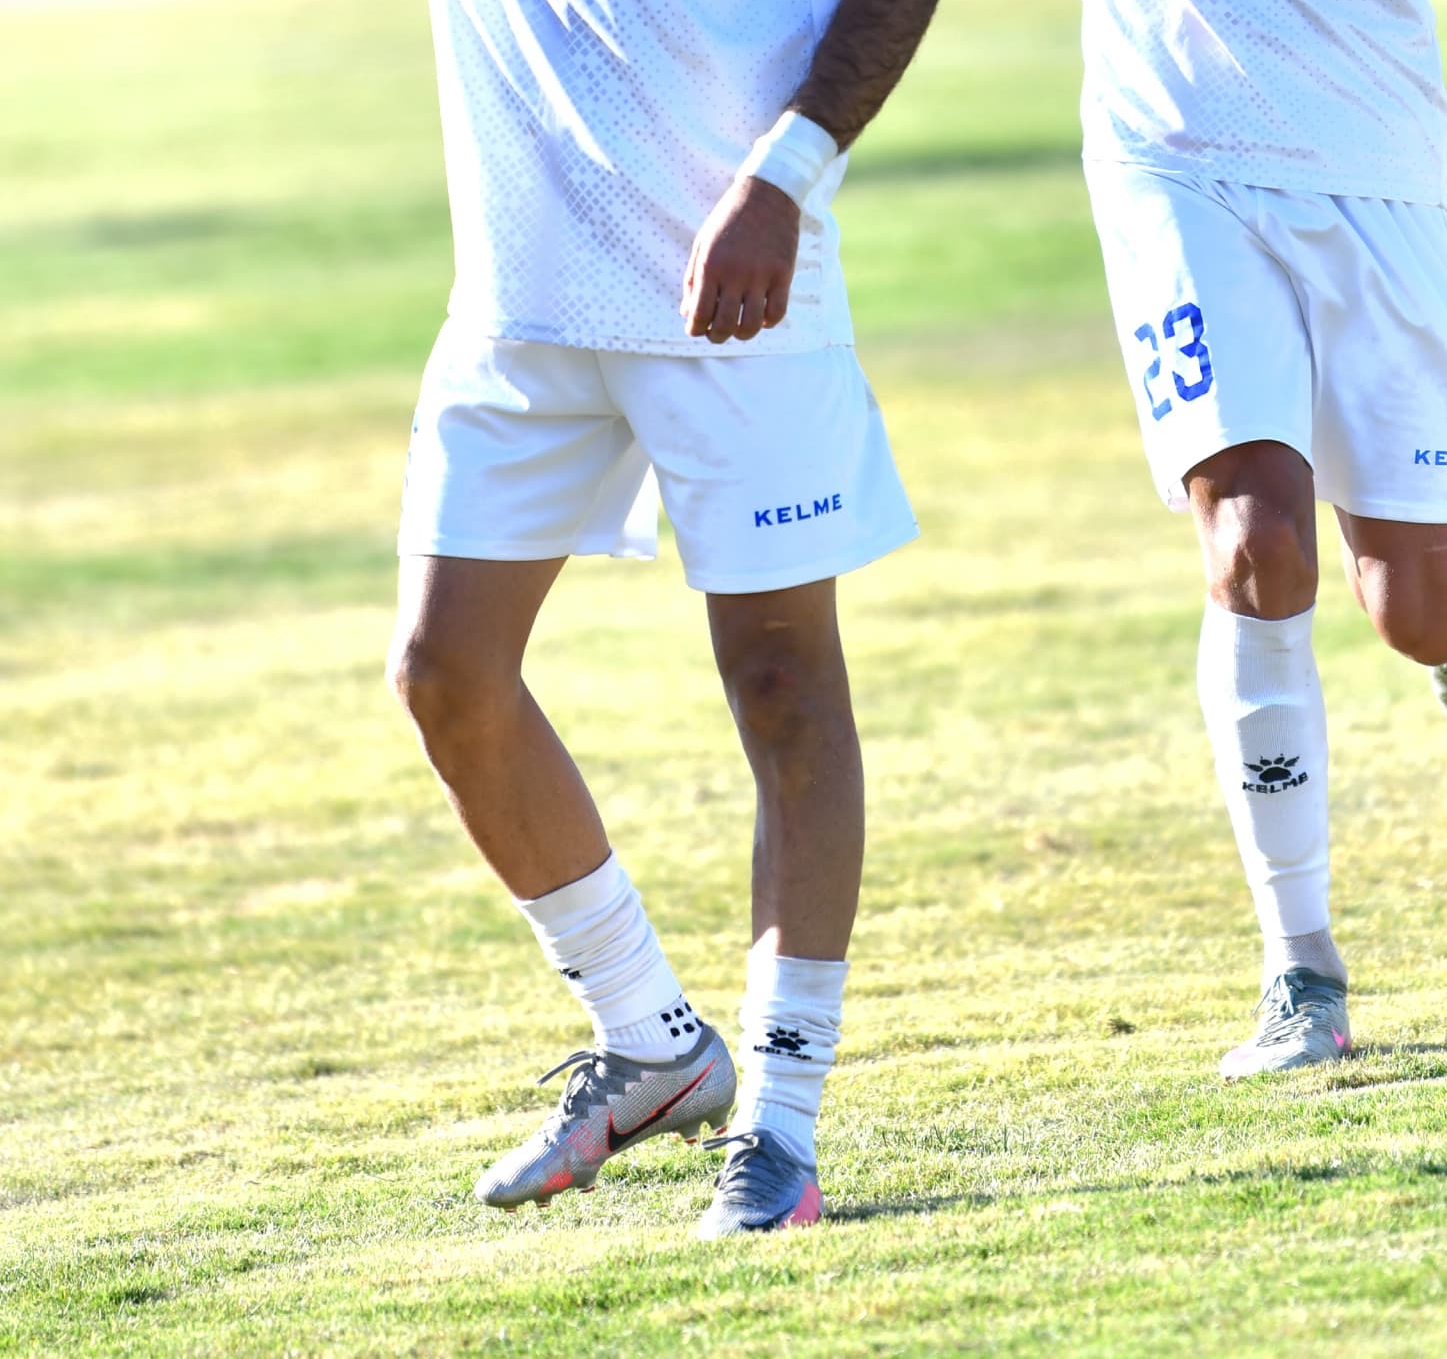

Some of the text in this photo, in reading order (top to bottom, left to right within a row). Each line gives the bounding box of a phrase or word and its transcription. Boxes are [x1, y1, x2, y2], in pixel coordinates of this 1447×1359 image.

[1134, 301, 1214, 421] 23
[754, 493, 842, 527] KELME
[1242, 772, 1308, 793] KELME
